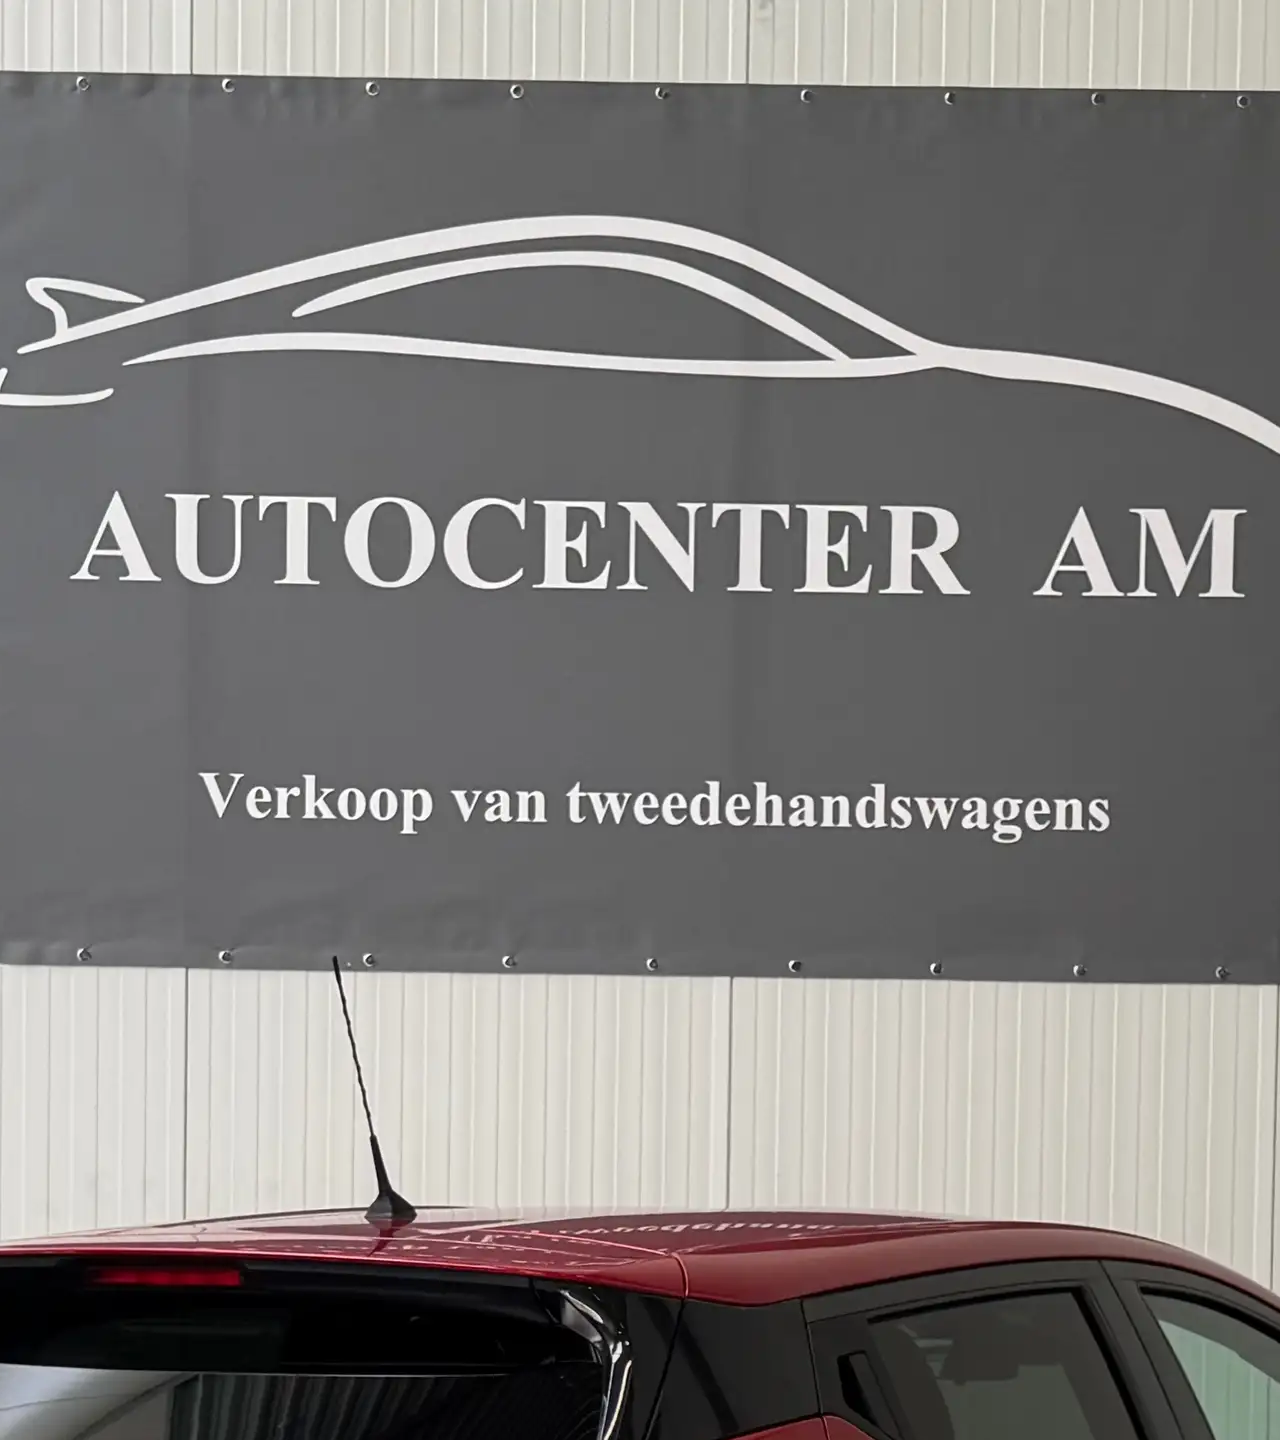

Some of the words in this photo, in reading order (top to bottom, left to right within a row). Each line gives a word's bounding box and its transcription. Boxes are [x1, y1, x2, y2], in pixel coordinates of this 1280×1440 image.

[69, 490, 971, 595] AUTOCENTER
[1032, 505, 1248, 598] AM
[198, 772, 433, 835] Verkoop
[450, 789, 548, 824] van
[565, 779, 1110, 844] tweedehandswagens
